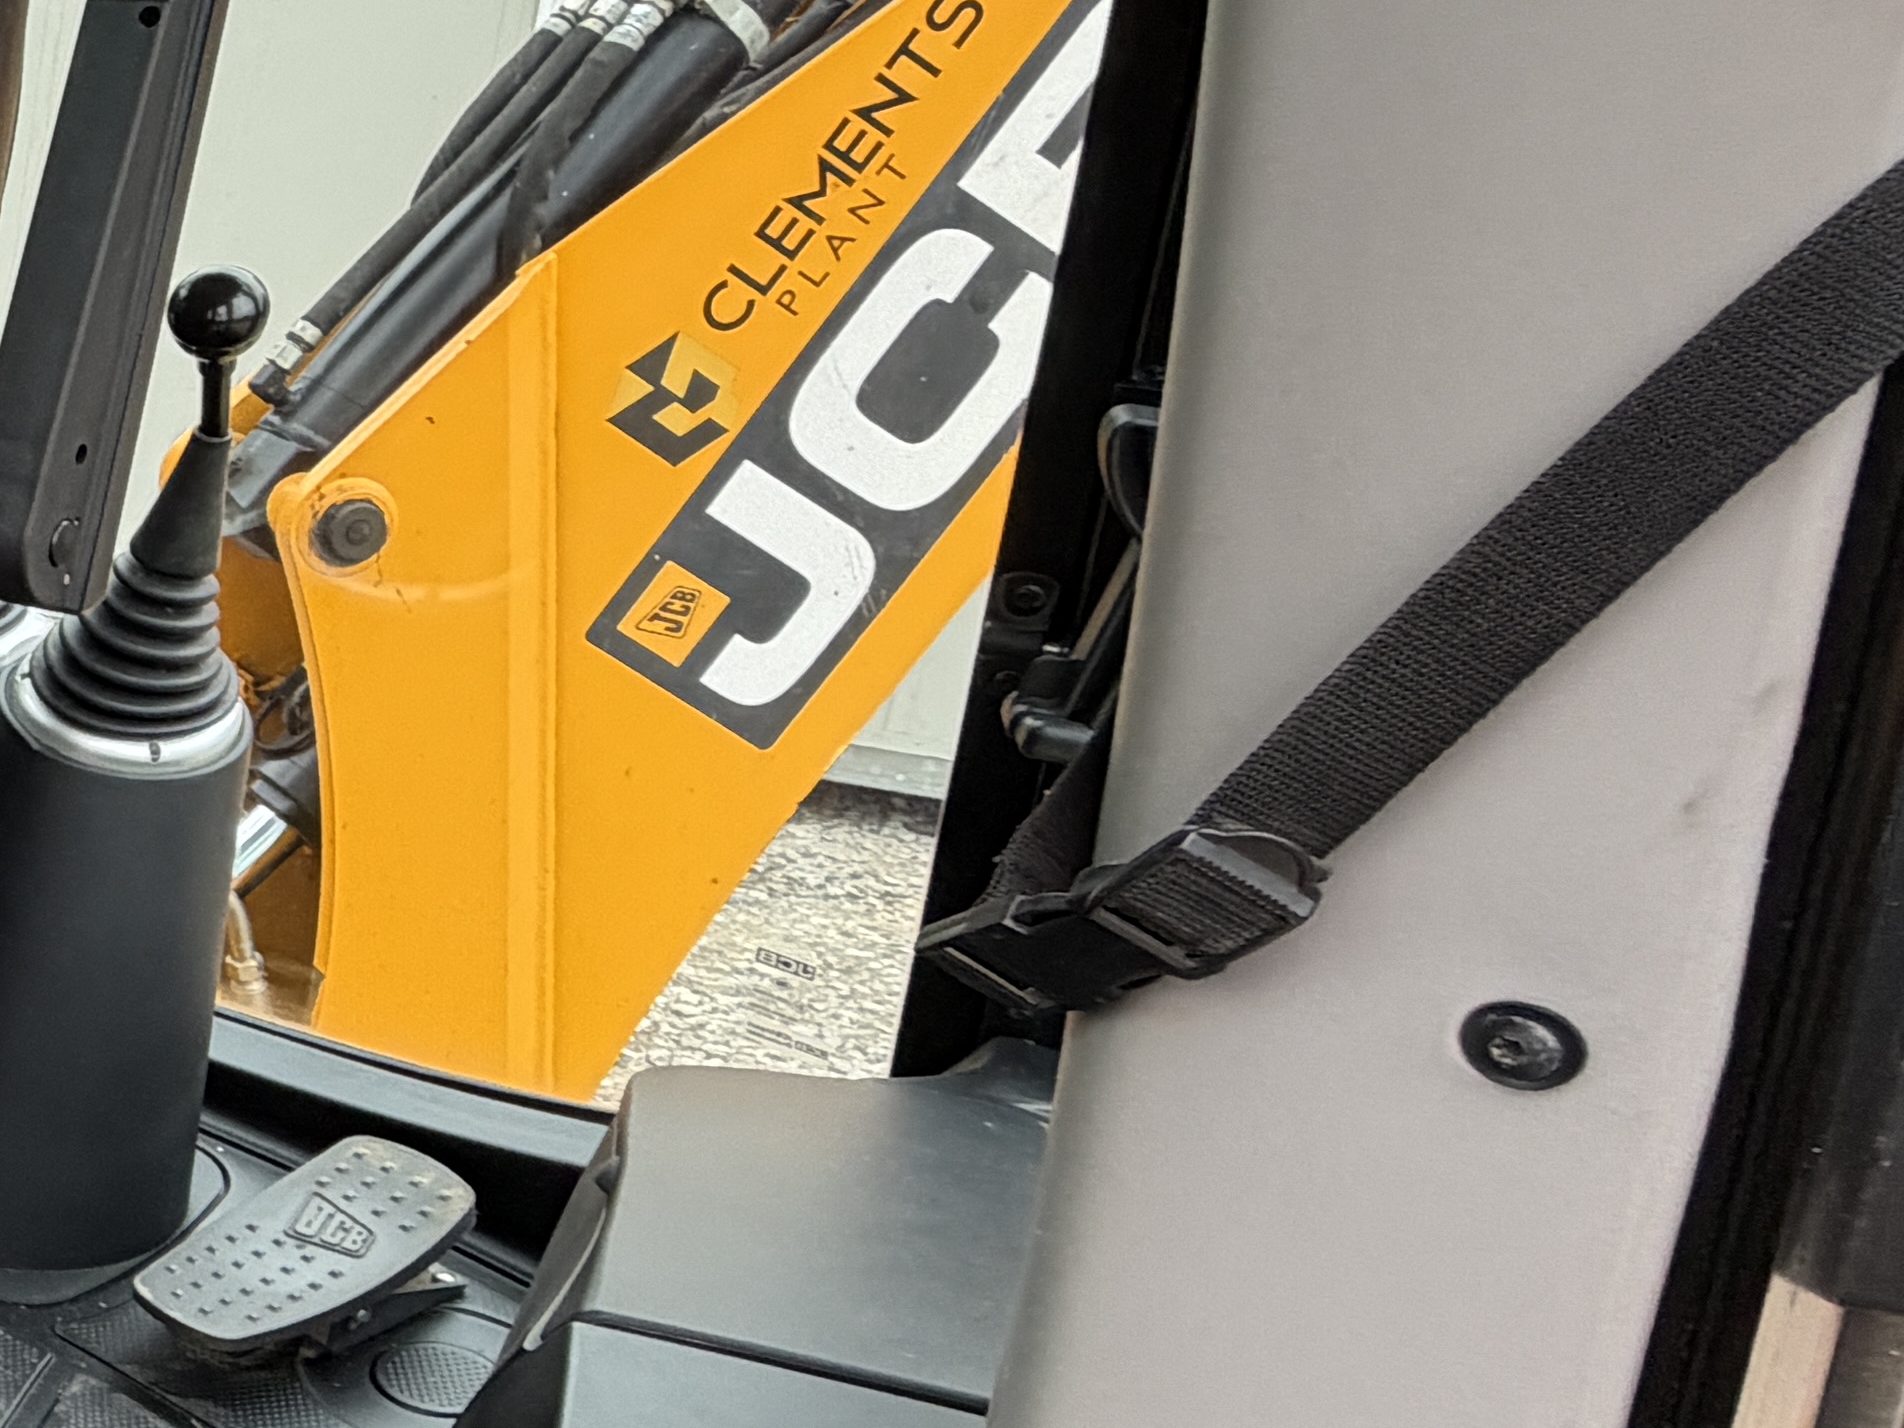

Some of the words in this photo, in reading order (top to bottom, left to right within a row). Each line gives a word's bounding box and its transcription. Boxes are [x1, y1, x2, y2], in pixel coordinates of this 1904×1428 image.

[775, 152, 908, 318] PLANT
[647, 589, 698, 634] JCB
[293, 1194, 372, 1253] JCB
